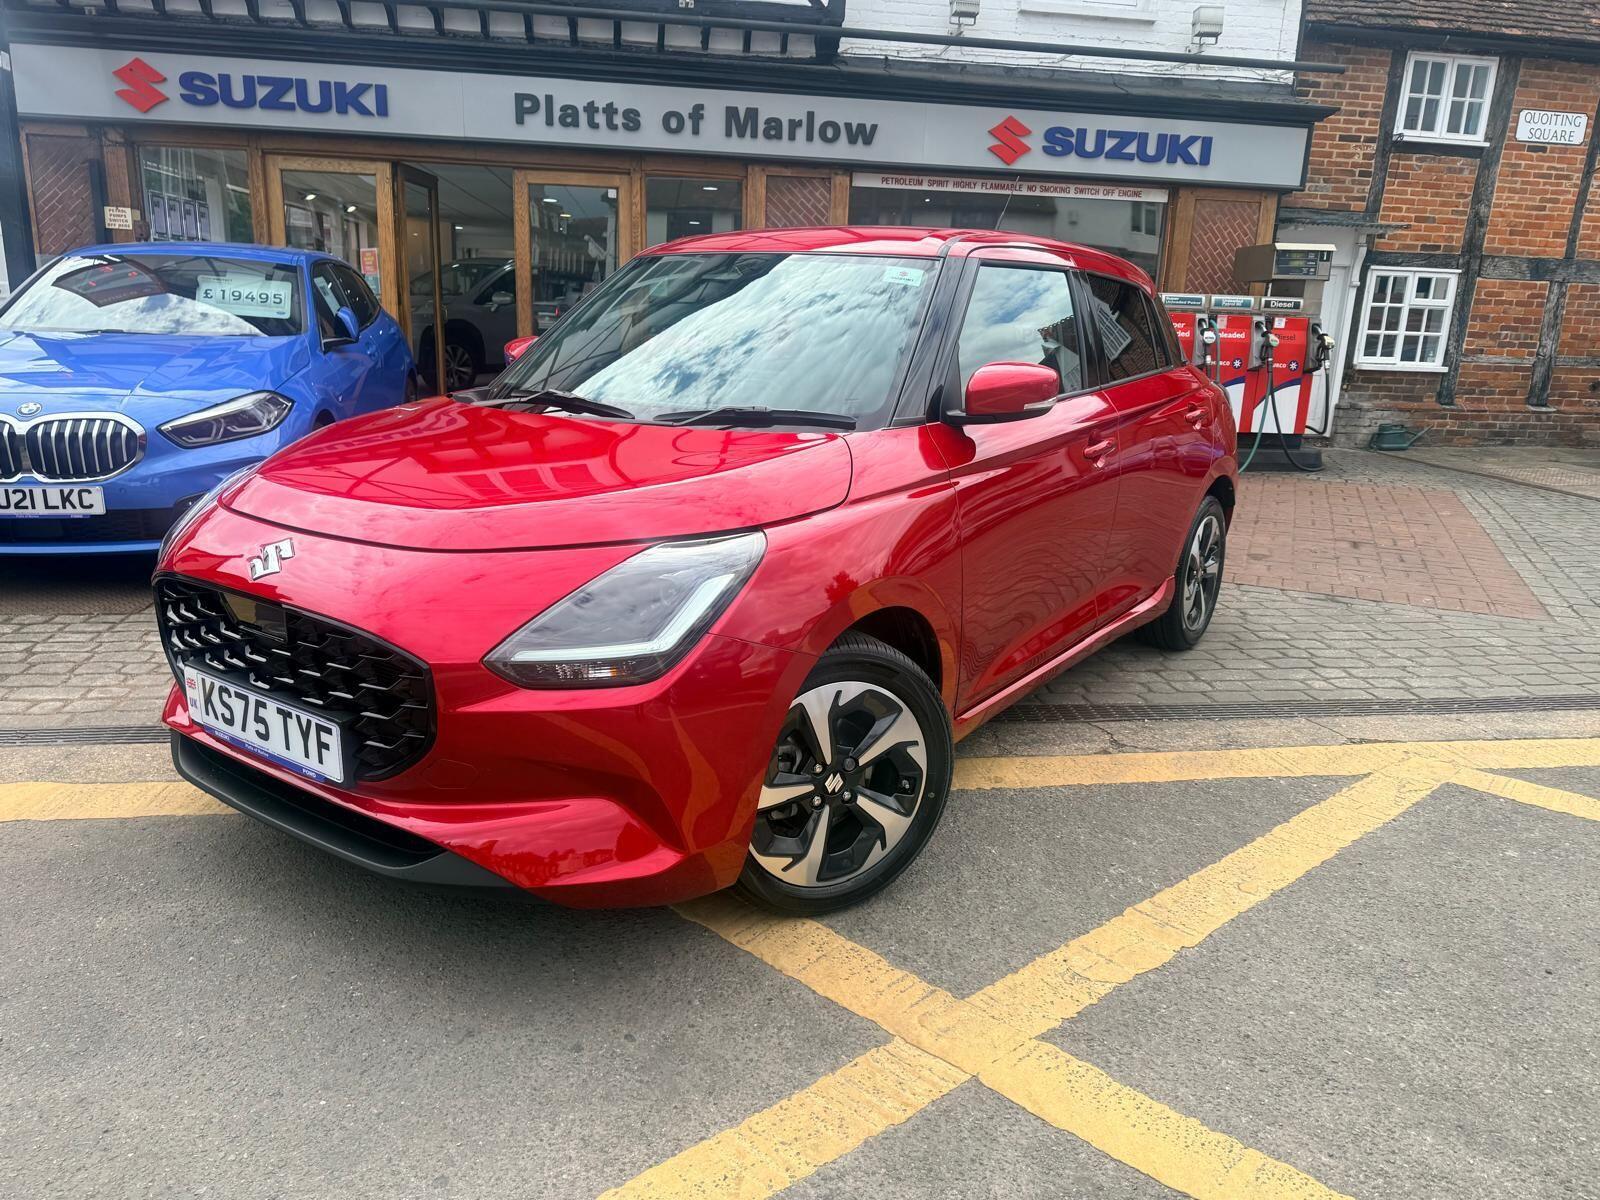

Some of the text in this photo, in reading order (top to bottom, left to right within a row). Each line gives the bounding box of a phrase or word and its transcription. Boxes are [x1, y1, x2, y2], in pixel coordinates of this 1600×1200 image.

[179, 71, 389, 117] SUZUKI
[514, 92, 879, 146] Platts of Marlow
[1524, 112, 1583, 128] QUOITING
[1528, 127, 1575, 142] SQUARE
[1042, 126, 1214, 167] SUZUKI
[881, 176, 1143, 198] PETROLEUM SPIRIT HIGHLY FLAMMABLE NO SMOKING SWITCH OFF ENGINE
[1270, 300, 1294, 308] Diesel
[1218, 331, 1246, 339] nleaded
[42, 489, 95, 510] LKC
[189, 697, 198, 709] UK
[201, 677, 333, 766] KS75 TYF
